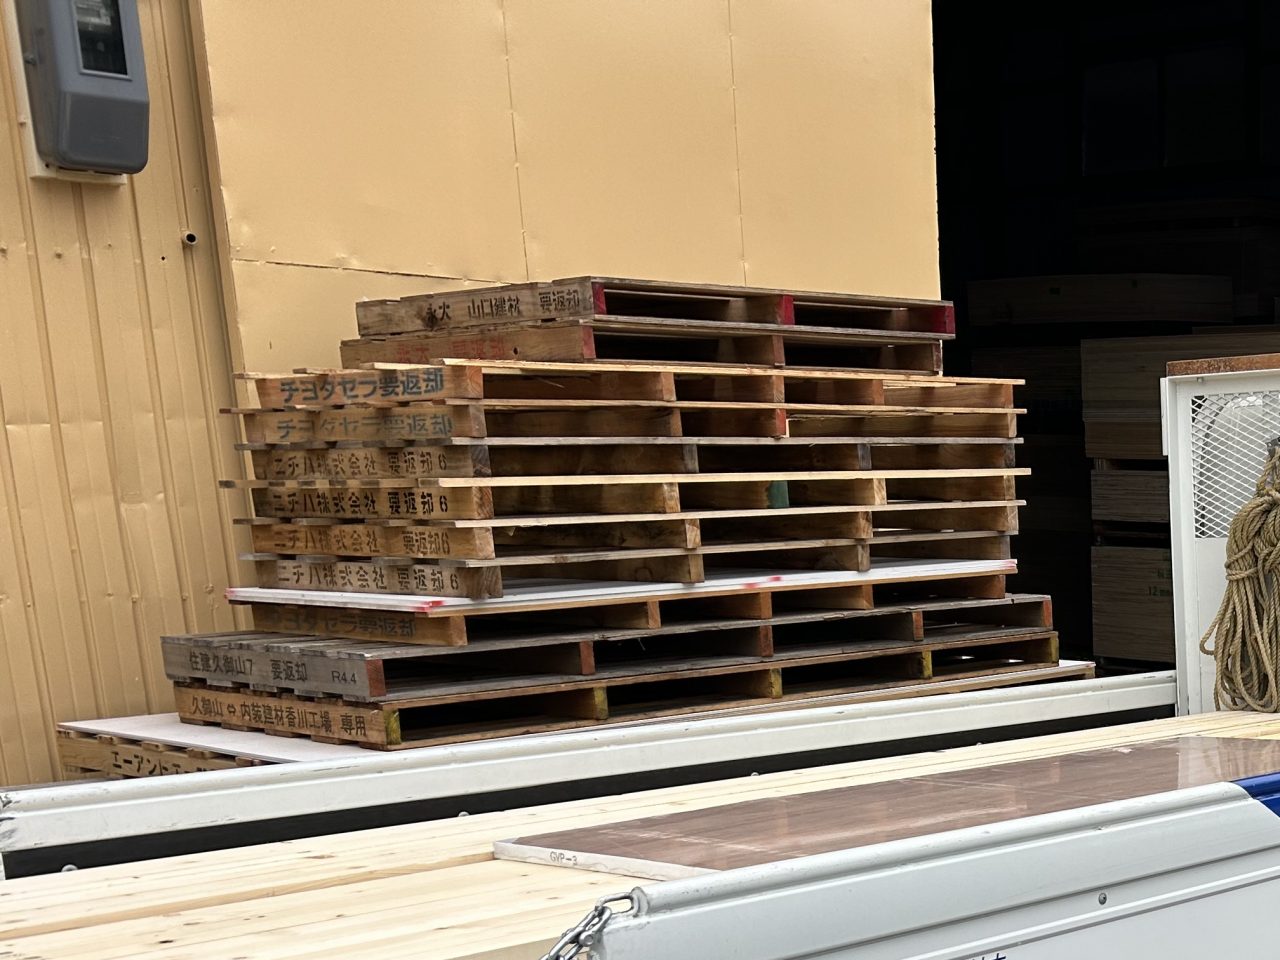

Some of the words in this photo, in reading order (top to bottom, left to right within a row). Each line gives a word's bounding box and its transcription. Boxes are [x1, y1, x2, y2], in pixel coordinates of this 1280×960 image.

[272, 491, 379, 515] ニチハ株式会社
[273, 529, 381, 554] ニチハ株式会社
[278, 564, 388, 590] ニチハ株式会社
[269, 658, 308, 682] 要返却
[331, 670, 357, 685] R4.4
[191, 695, 223, 718] 久御山
[240, 700, 333, 733] 内装建材香川工場
[339, 712, 367, 737] 専用
